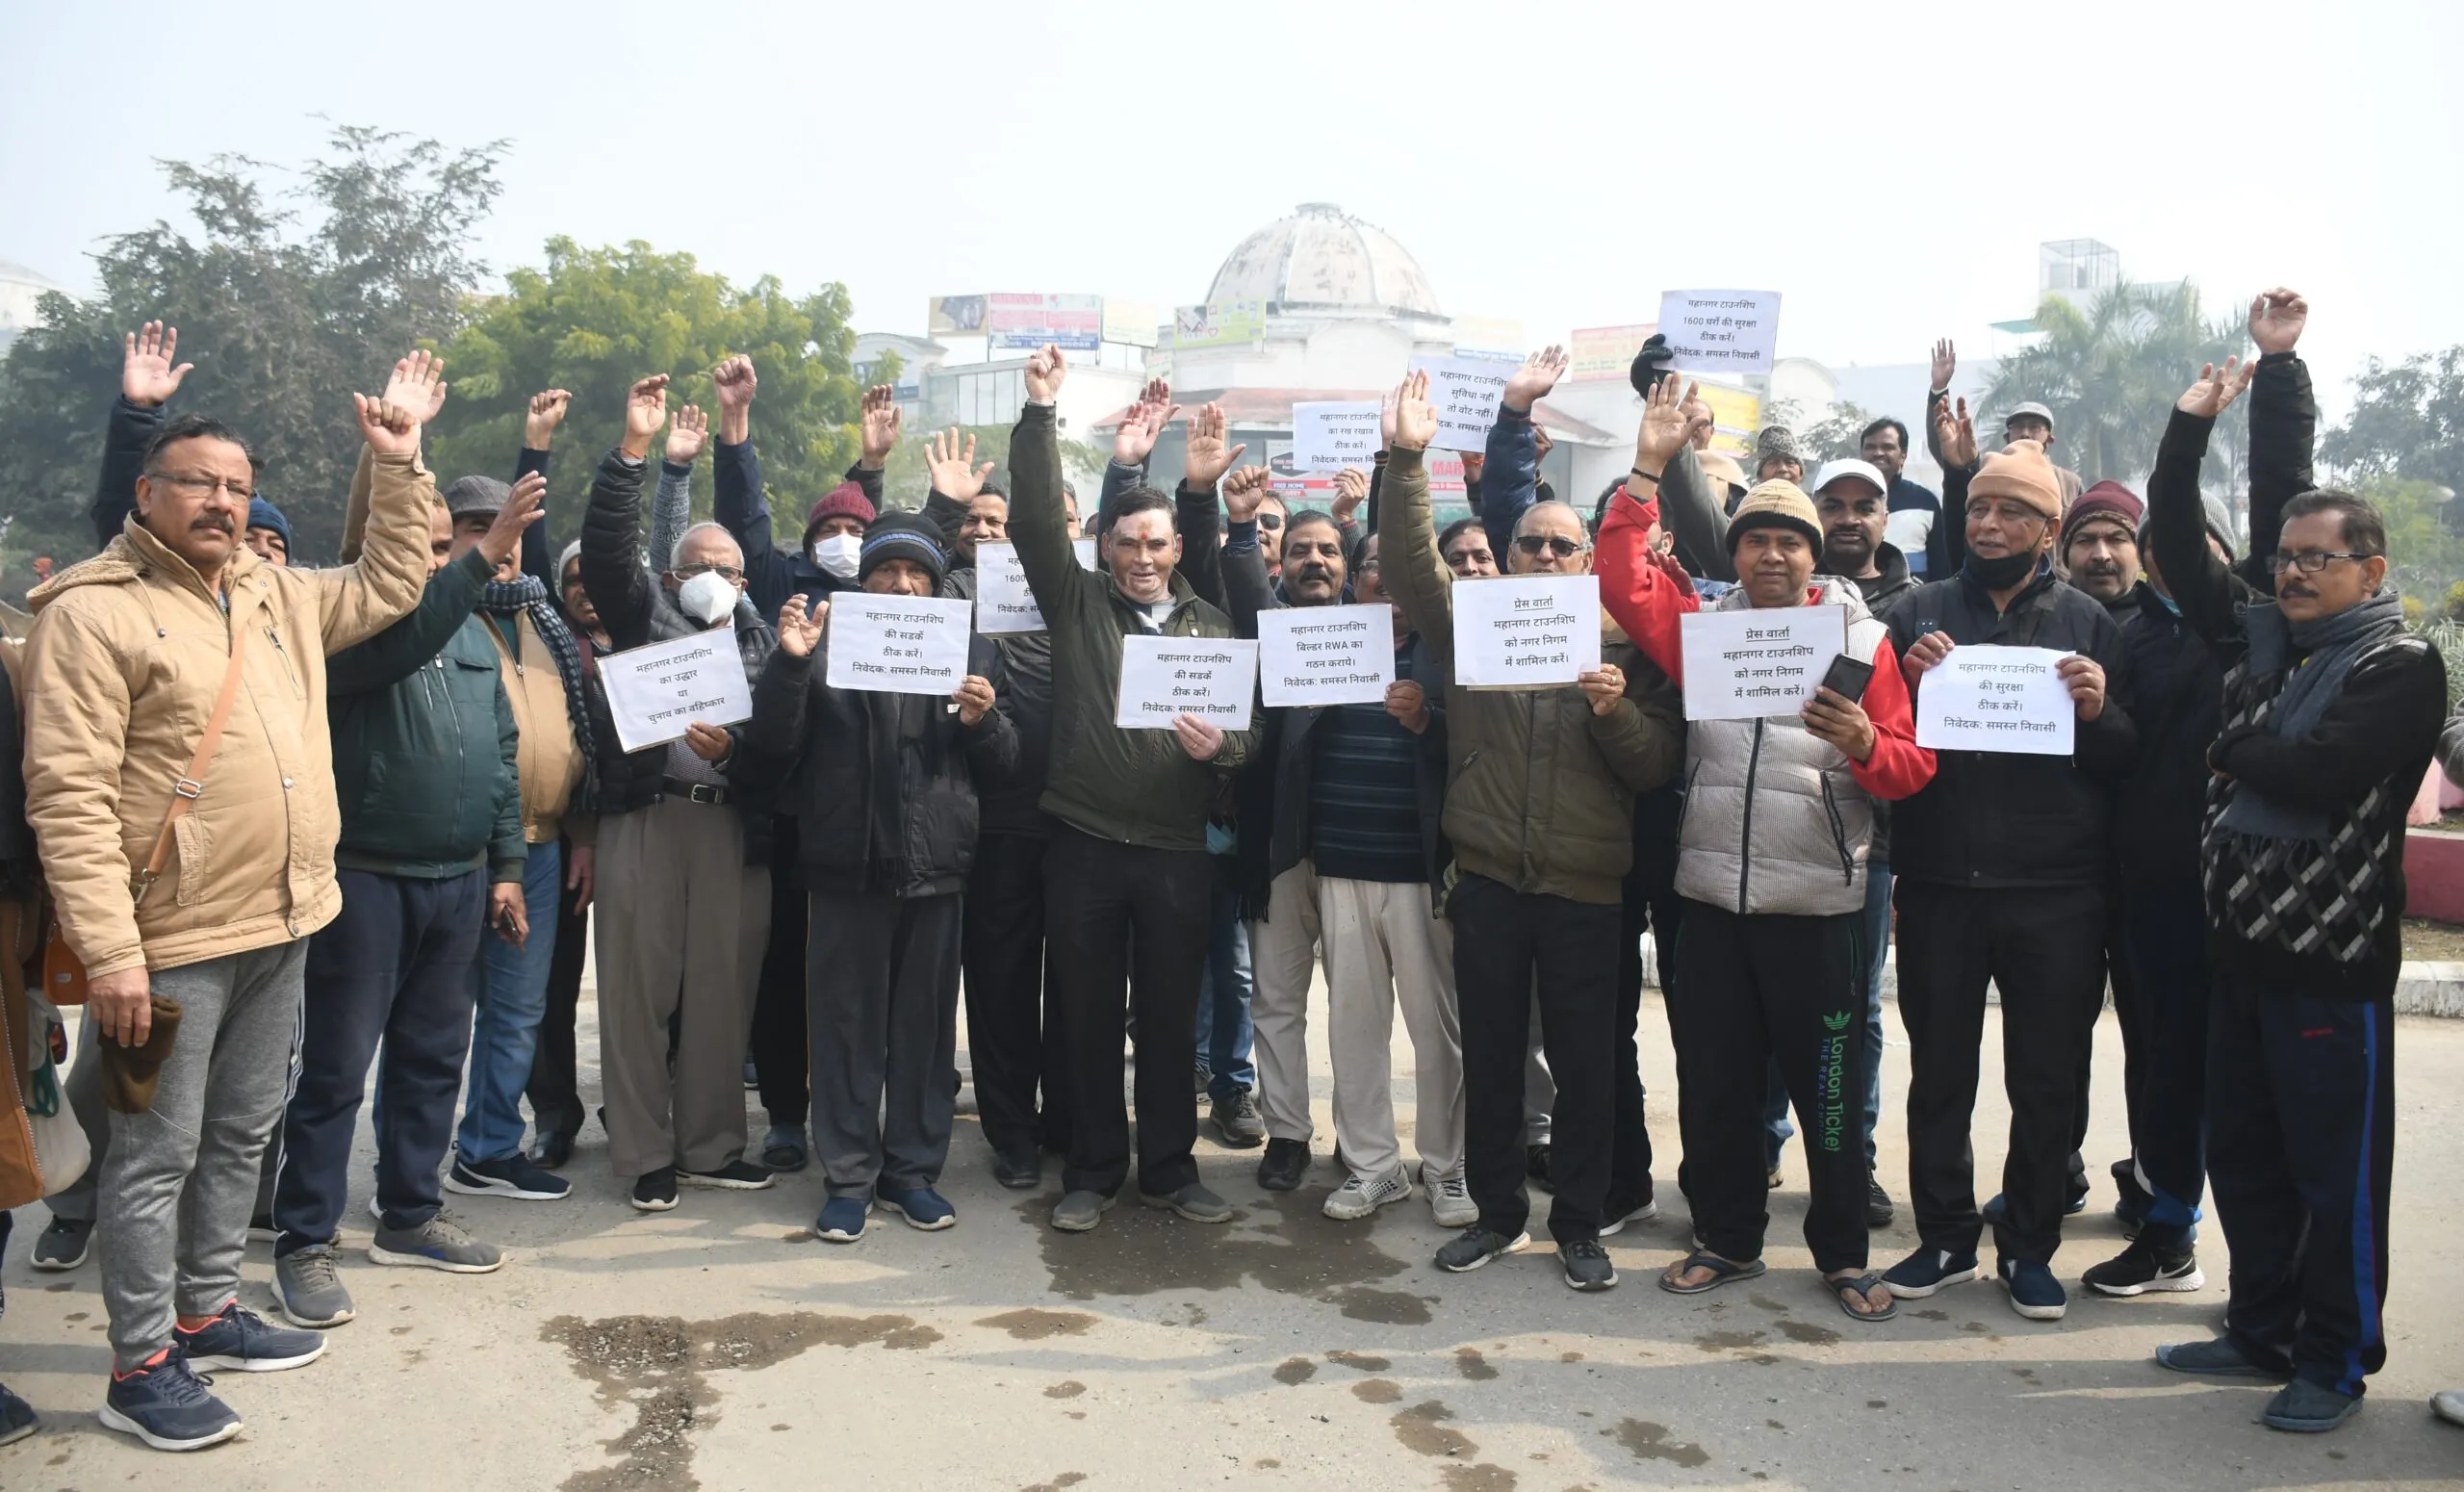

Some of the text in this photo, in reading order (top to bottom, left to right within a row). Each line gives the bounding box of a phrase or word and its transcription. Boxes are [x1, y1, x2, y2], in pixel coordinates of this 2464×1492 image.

[1720, 299, 1756, 309] टाउनशिप
[1683, 317, 1704, 325] 1600
[1721, 318, 1732, 327] की
[1734, 320, 1757, 329] सुरक्षा
[1700, 331, 1734, 343] ठीक करें।
[1675, 347, 1759, 360] निवेदक: समस्त निवासी
[1440, 371, 1471, 381] महानगर
[1451, 388, 1495, 402] सुविधा नहीं
[1448, 403, 1494, 419] तो वोट नहीं।
[1457, 423, 1481, 433] समस्त
[1311, 455, 1339, 464] निवेदक:
[1515, 595, 1553, 608] प्रेस वार्ता
[998, 605, 1028, 613] निवेदक:
[866, 612, 944, 624] महानगर टाउनशिप
[1494, 614, 1575, 630] महानगर टाउनशिप
[885, 629, 897, 639] की
[1291, 621, 1367, 635] महानगर टाउनशिप
[1746, 626, 1790, 639] प्रेस वार्ता
[1296, 640, 1363, 651] बिल्डर RWA का
[1504, 634, 1567, 647] को नगर निगम
[884, 646, 922, 658] ठीक करें।
[1157, 654, 1232, 663] महानगर टाउनशिप
[1723, 645, 1813, 660] महानगर टाउनशिप
[635, 648, 712, 673] महानगर टाउनशिप
[1516, 655, 1548, 666] शामिल
[1551, 653, 1569, 663] करें।
[853, 662, 951, 678] निवेदक: समस्त निवासी
[1734, 666, 1804, 678] को नगर निगम
[1959, 662, 2046, 674] महानगर टाउनशिप
[659, 670, 698, 685] का उद्धार
[1174, 670, 1186, 680] की
[1284, 673, 1380, 687] निवेदक: समस्त निवासी
[1172, 686, 1210, 697] ठीक करें।
[1746, 685, 1781, 697] शामिल
[1784, 684, 1804, 695] करें।
[1979, 680, 2023, 694] की सुरक्षा
[678, 689, 688, 699] या
[1142, 702, 1175, 712] निवेदक:
[1207, 704, 1236, 713] निवासी
[1978, 699, 2022, 711] ठीक करें।
[648, 710, 672, 724] चुनाव
[674, 707, 686, 716] का
[1944, 716, 2056, 733] निवेदक: समस्त निवासी
[1821, 1038, 1831, 1061] THE
[1827, 1035, 1848, 1099] London
[1817, 1066, 1827, 1096] REAL
